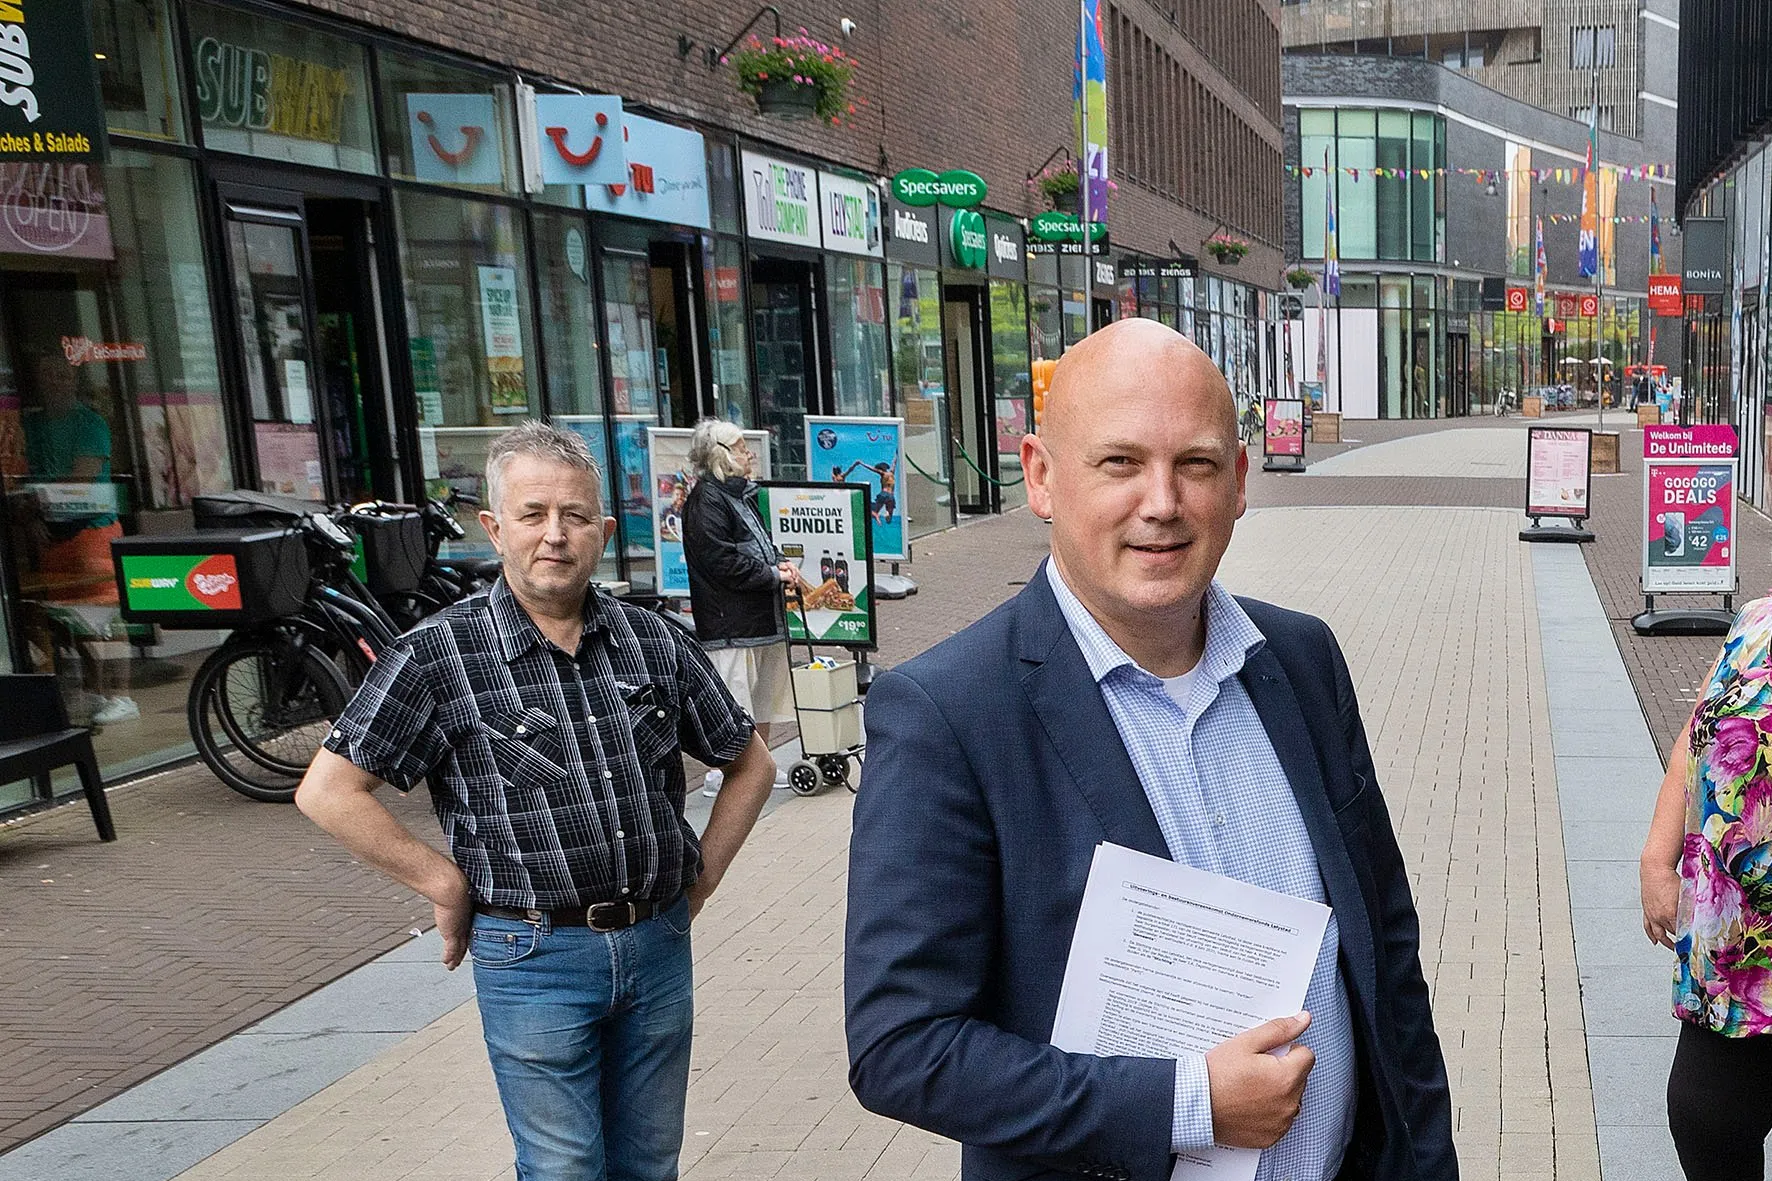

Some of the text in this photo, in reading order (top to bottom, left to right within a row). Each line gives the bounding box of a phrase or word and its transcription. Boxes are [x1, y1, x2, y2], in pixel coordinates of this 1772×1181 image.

[196, 36, 354, 144] SUBWAY
[33, 132, 45, 152] &
[47, 133, 91, 153] Salads
[899, 179, 978, 197] Specsavers
[1650, 285, 1680, 296] HEMA
[1650, 432, 1693, 441] Welkom bij
[1650, 442, 1733, 454] De Unlimiteds
[1664, 477, 1717, 489] GOGOGO
[1664, 489, 1717, 504] DEALS
[791, 507, 843, 516] MATCH DAY
[779, 518, 844, 534] BUNDLE
[130, 577, 179, 588] SUBWAY
